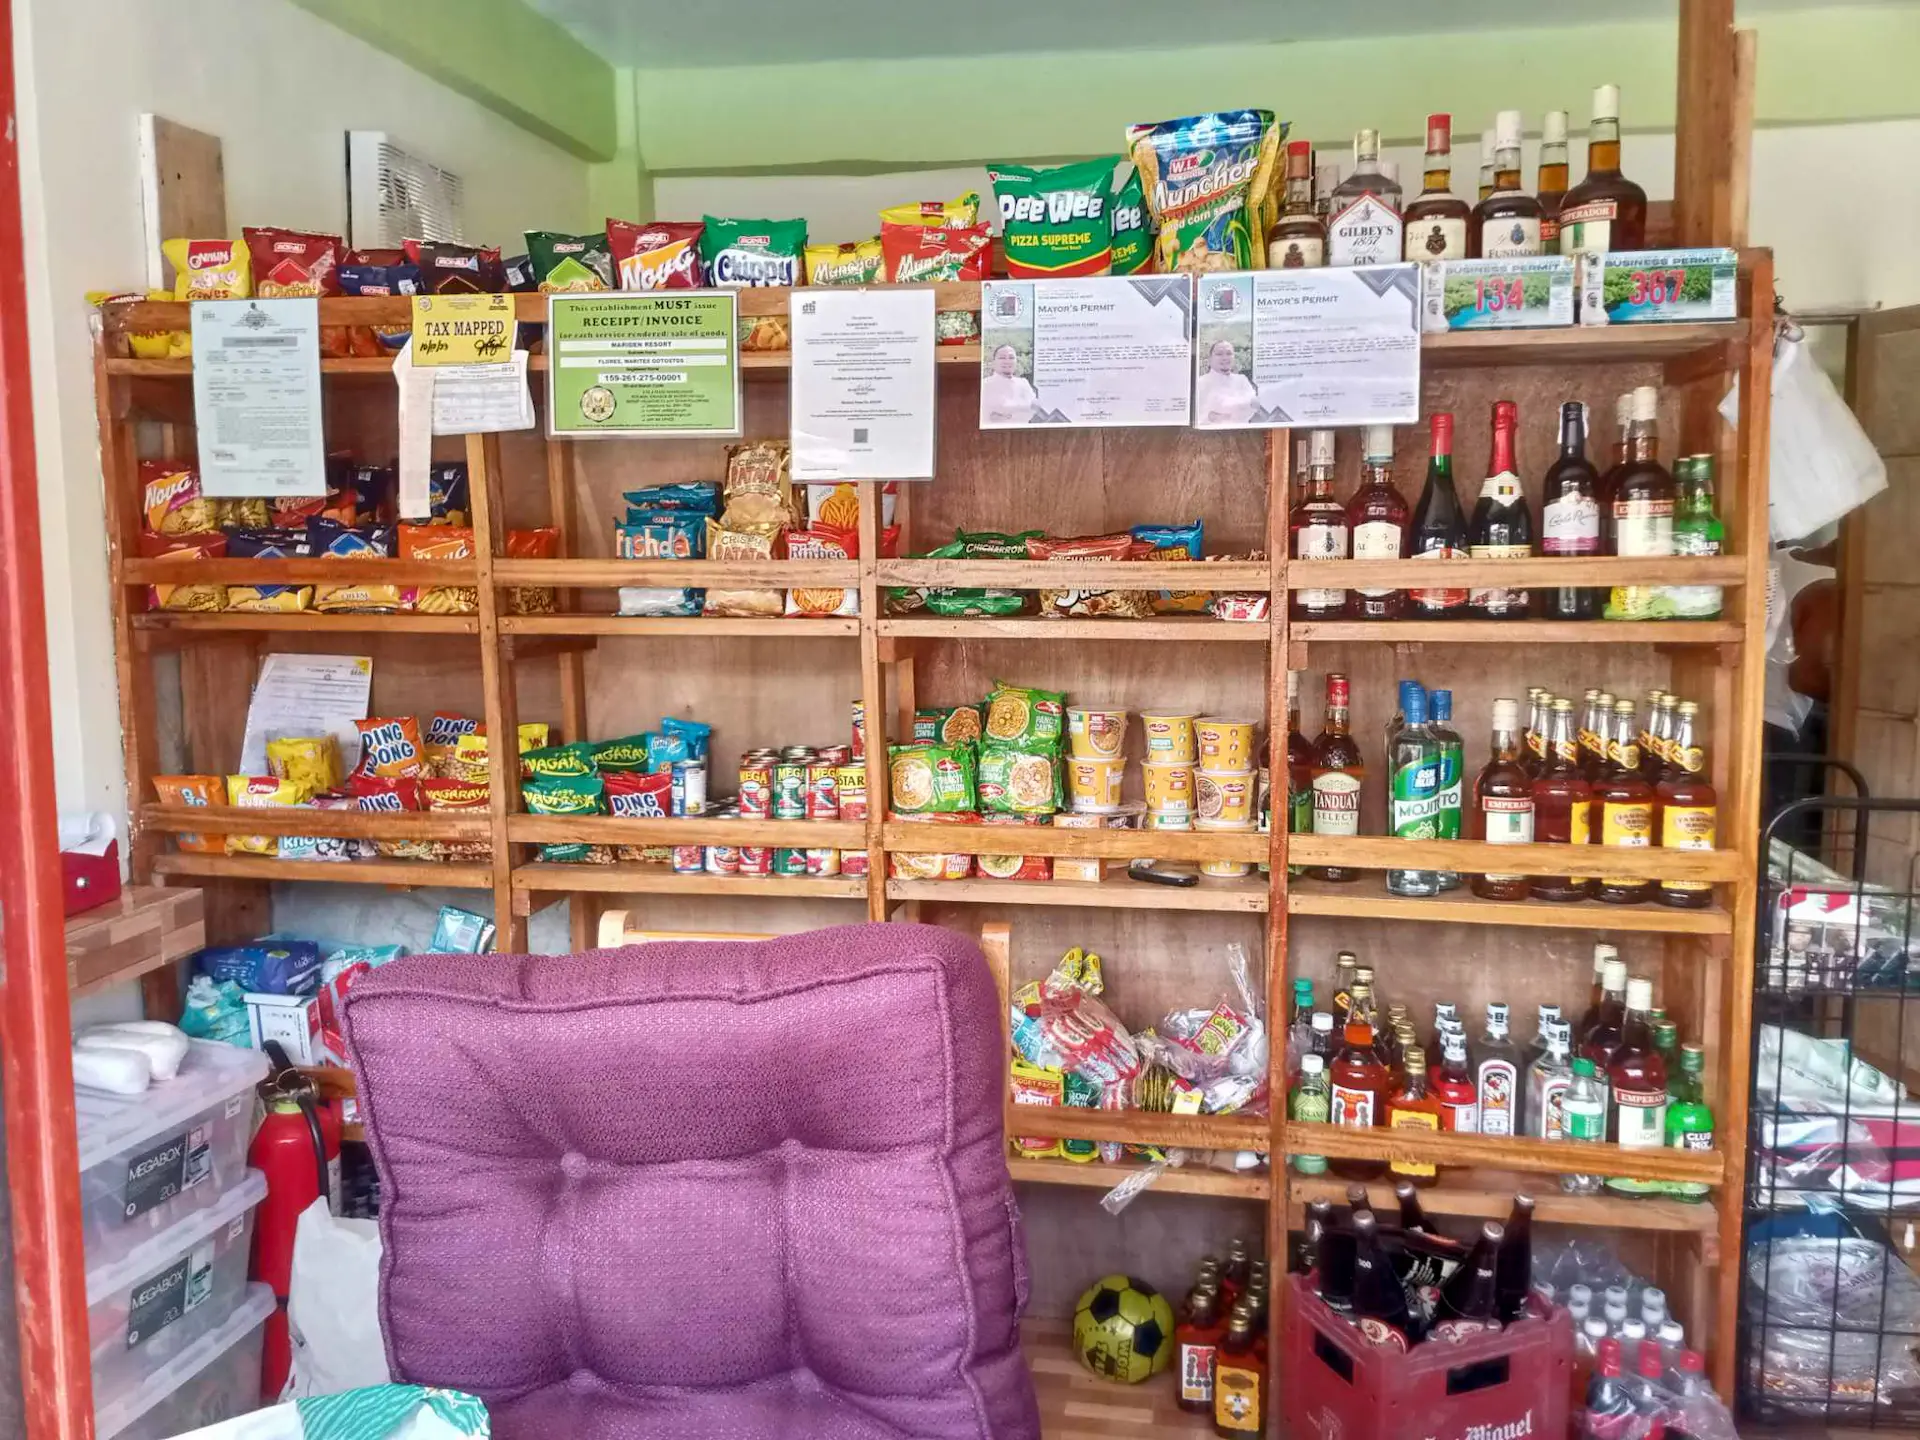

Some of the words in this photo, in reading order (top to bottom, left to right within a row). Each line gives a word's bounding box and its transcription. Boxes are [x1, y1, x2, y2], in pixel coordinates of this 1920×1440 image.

[1010, 234, 1040, 247] PIZZA
[1041, 232, 1092, 247] SUPREME
[1339, 226, 1394, 238] GILBEY'S
[1352, 236, 1381, 247] 1857
[620, 247, 698, 291] Nova
[1354, 257, 1377, 266] GIN
[1512, 263, 1561, 271] PERMIT
[1604, 257, 1668, 268] BUSINESS
[1671, 255, 1722, 266] PERMIT
[717, 254, 792, 288] Chippy
[1474, 275, 1525, 313] 134
[1630, 269, 1686, 306] 367
[570, 304, 589, 313] This
[590, 303, 652, 312] establishment
[654, 300, 692, 311] MUST
[694, 302, 717, 311] issue
[425, 322, 450, 337] TAX
[454, 320, 504, 337] MAPPED
[582, 315, 703, 327] RECEIPT/INVOICE
[573, 331, 593, 339] each
[595, 331, 625, 339] service
[644, 340, 672, 348] RESORT
[144, 475, 192, 515] Nova
[966, 542, 1025, 555] CHICHARRON
[1149, 547, 1187, 562] SUPER
[432, 717, 477, 733] DING
[362, 722, 402, 749] DING
[371, 742, 415, 766] DONG
[739, 770, 768, 784] MEGA
[839, 775, 865, 787] STAR
[359, 794, 401, 811] DING
[612, 794, 657, 811] DING
[1313, 791, 1360, 810] TANDUAY
[1488, 800, 1533, 810] EMPERAD
[1316, 811, 1355, 820] SELECT
[1621, 1093, 1666, 1104] EMPERAD
[128, 1144, 182, 1182] MEGABOX
[131, 1269, 184, 1310] MEGABOX
[1465, 1409, 1532, 1440] Miguel
